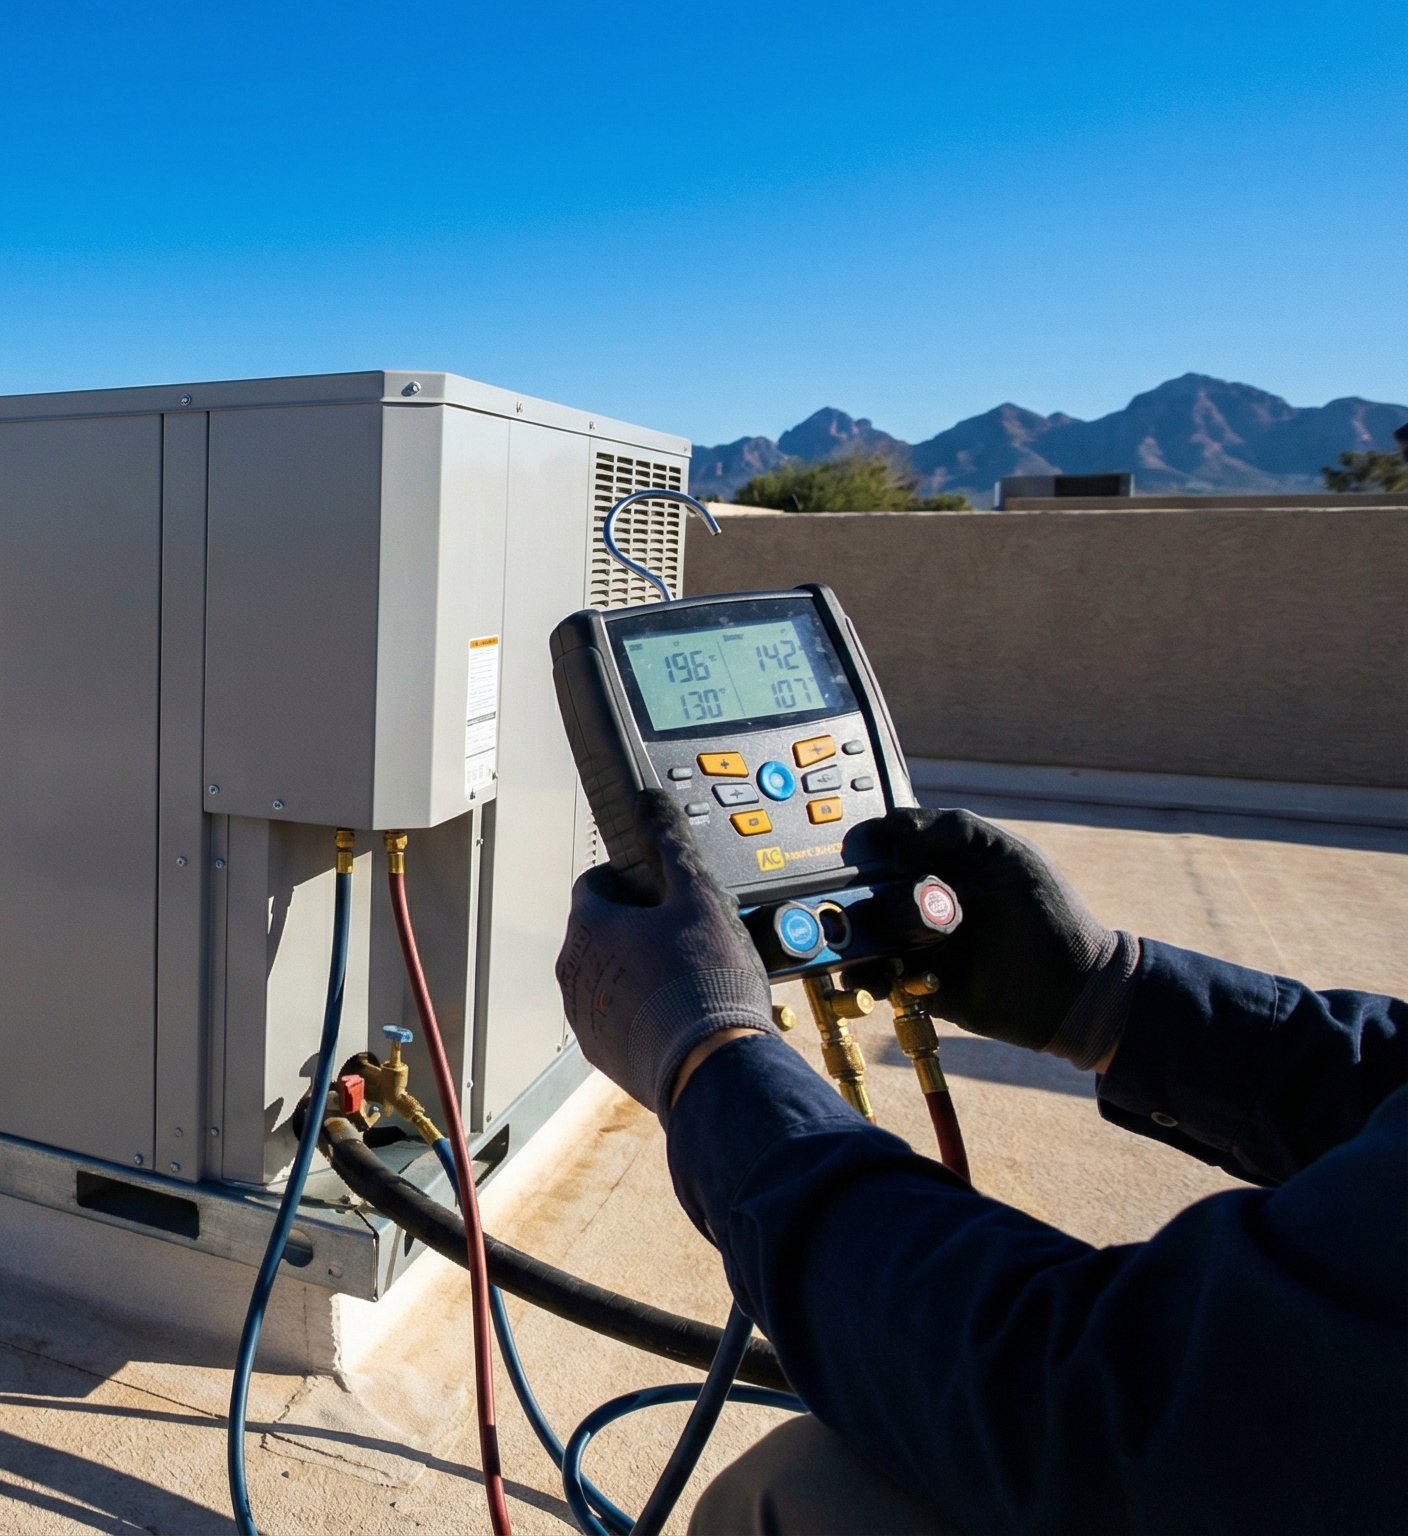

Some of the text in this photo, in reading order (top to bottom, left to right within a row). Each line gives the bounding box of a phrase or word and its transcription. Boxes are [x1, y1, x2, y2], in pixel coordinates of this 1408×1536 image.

[664, 650, 712, 684] 196
[756, 640, 800, 672] 142
[680, 688, 724, 721] 130
[771, 678, 812, 709] 107
[761, 848, 782, 869] AC
